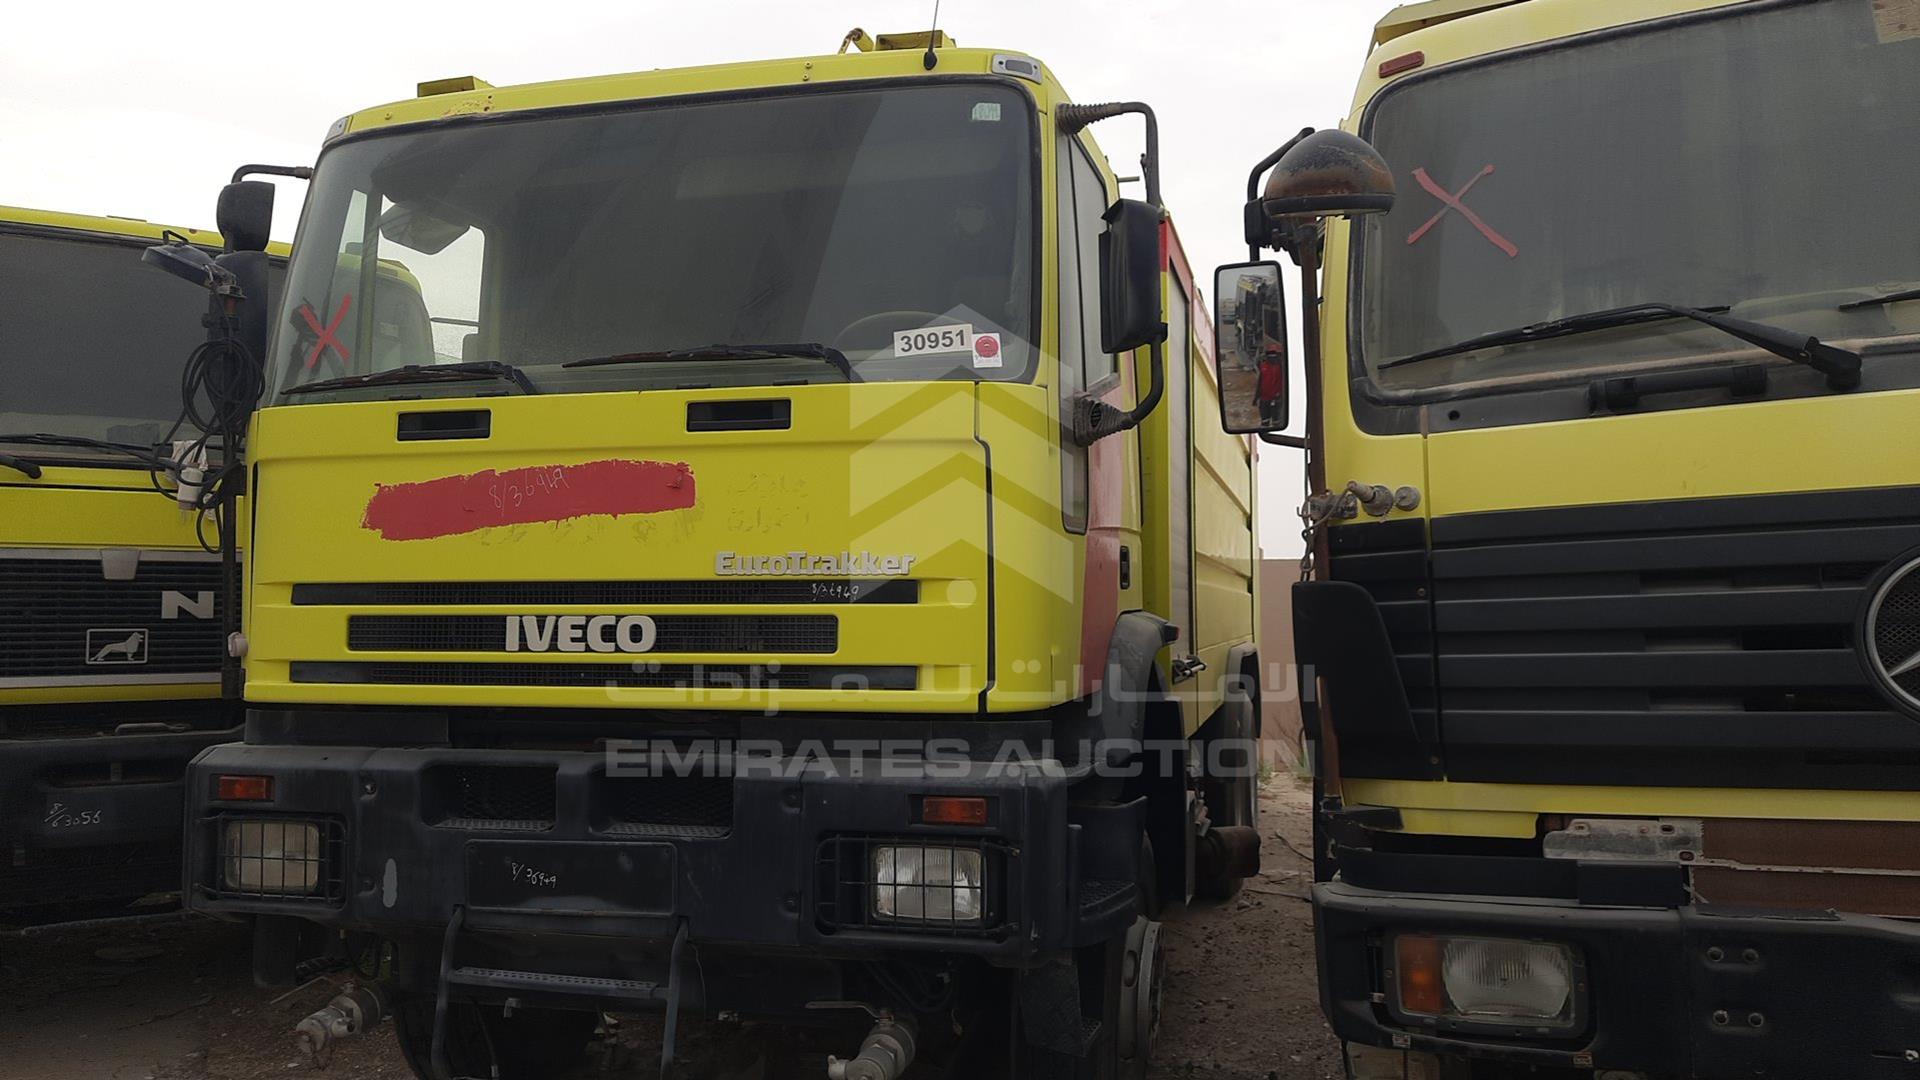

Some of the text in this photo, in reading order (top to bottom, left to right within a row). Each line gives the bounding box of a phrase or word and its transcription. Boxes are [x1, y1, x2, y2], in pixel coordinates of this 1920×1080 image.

[900, 329, 966, 353] 30951
[714, 551, 917, 577] EuroTrakker
[161, 590, 215, 619] N
[505, 614, 657, 653] IVECO
